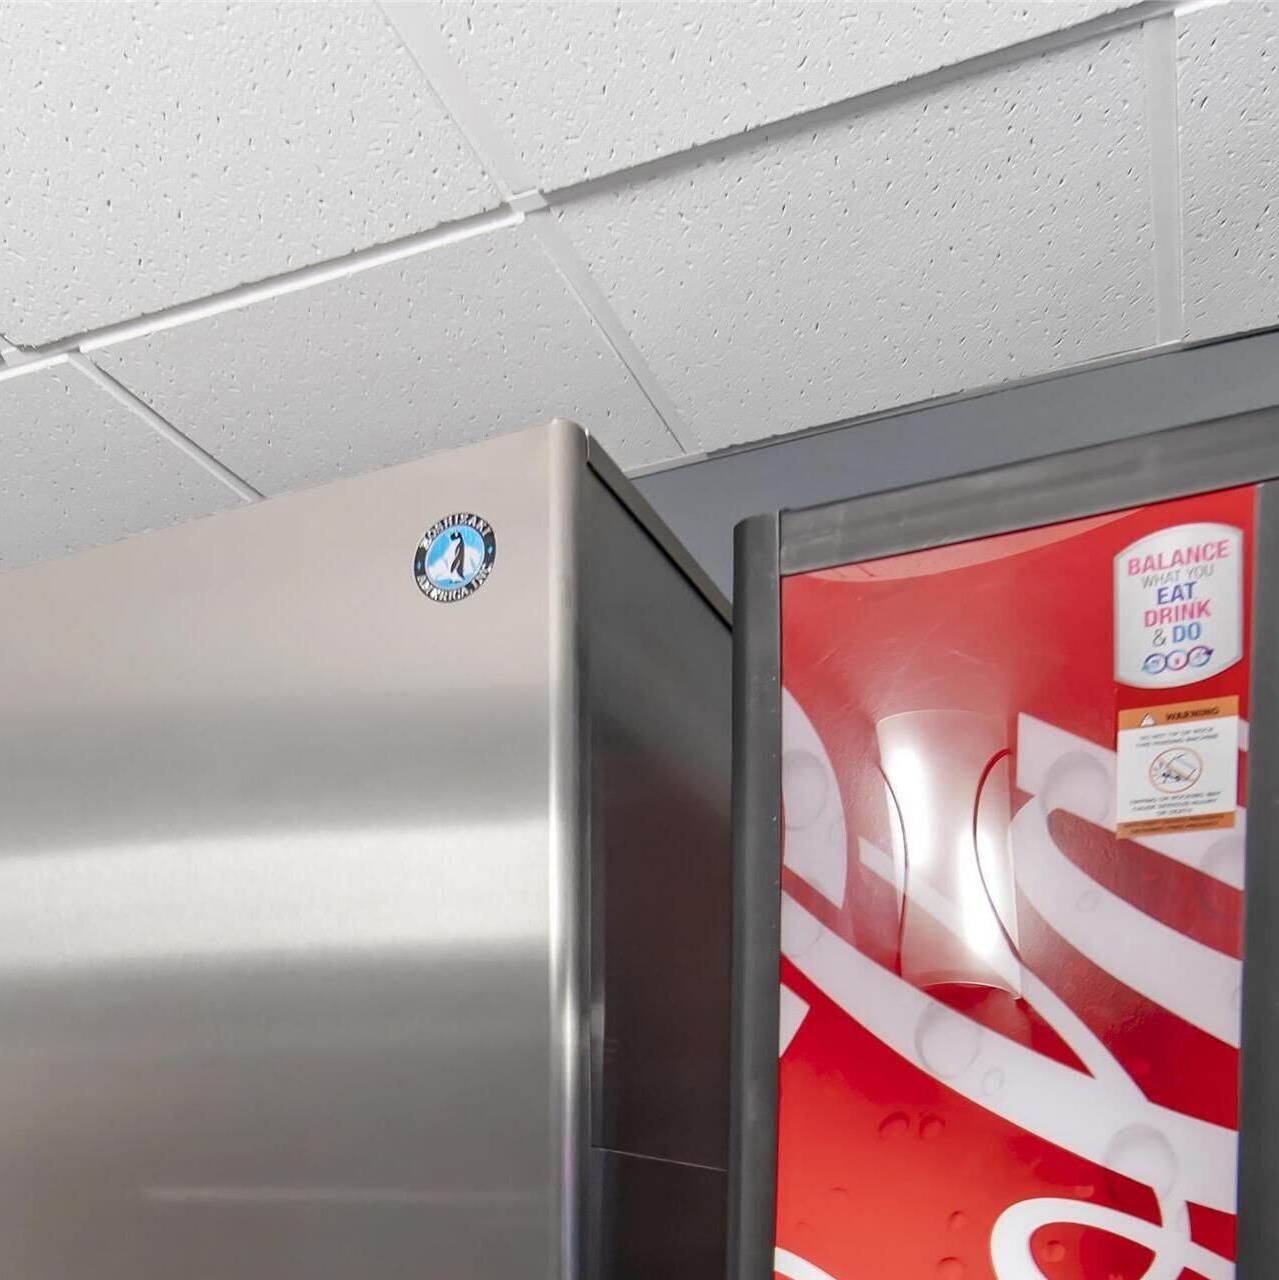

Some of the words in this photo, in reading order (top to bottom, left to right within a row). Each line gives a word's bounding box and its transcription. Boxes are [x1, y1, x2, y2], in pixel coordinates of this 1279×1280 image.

[1127, 540, 1230, 577] BALANCE
[1142, 570, 1181, 589] WHAT
[1187, 563, 1215, 579] YOU
[1157, 580, 1197, 605] EAT
[1143, 600, 1212, 628] DRINK
[1172, 622, 1202, 643] DO
